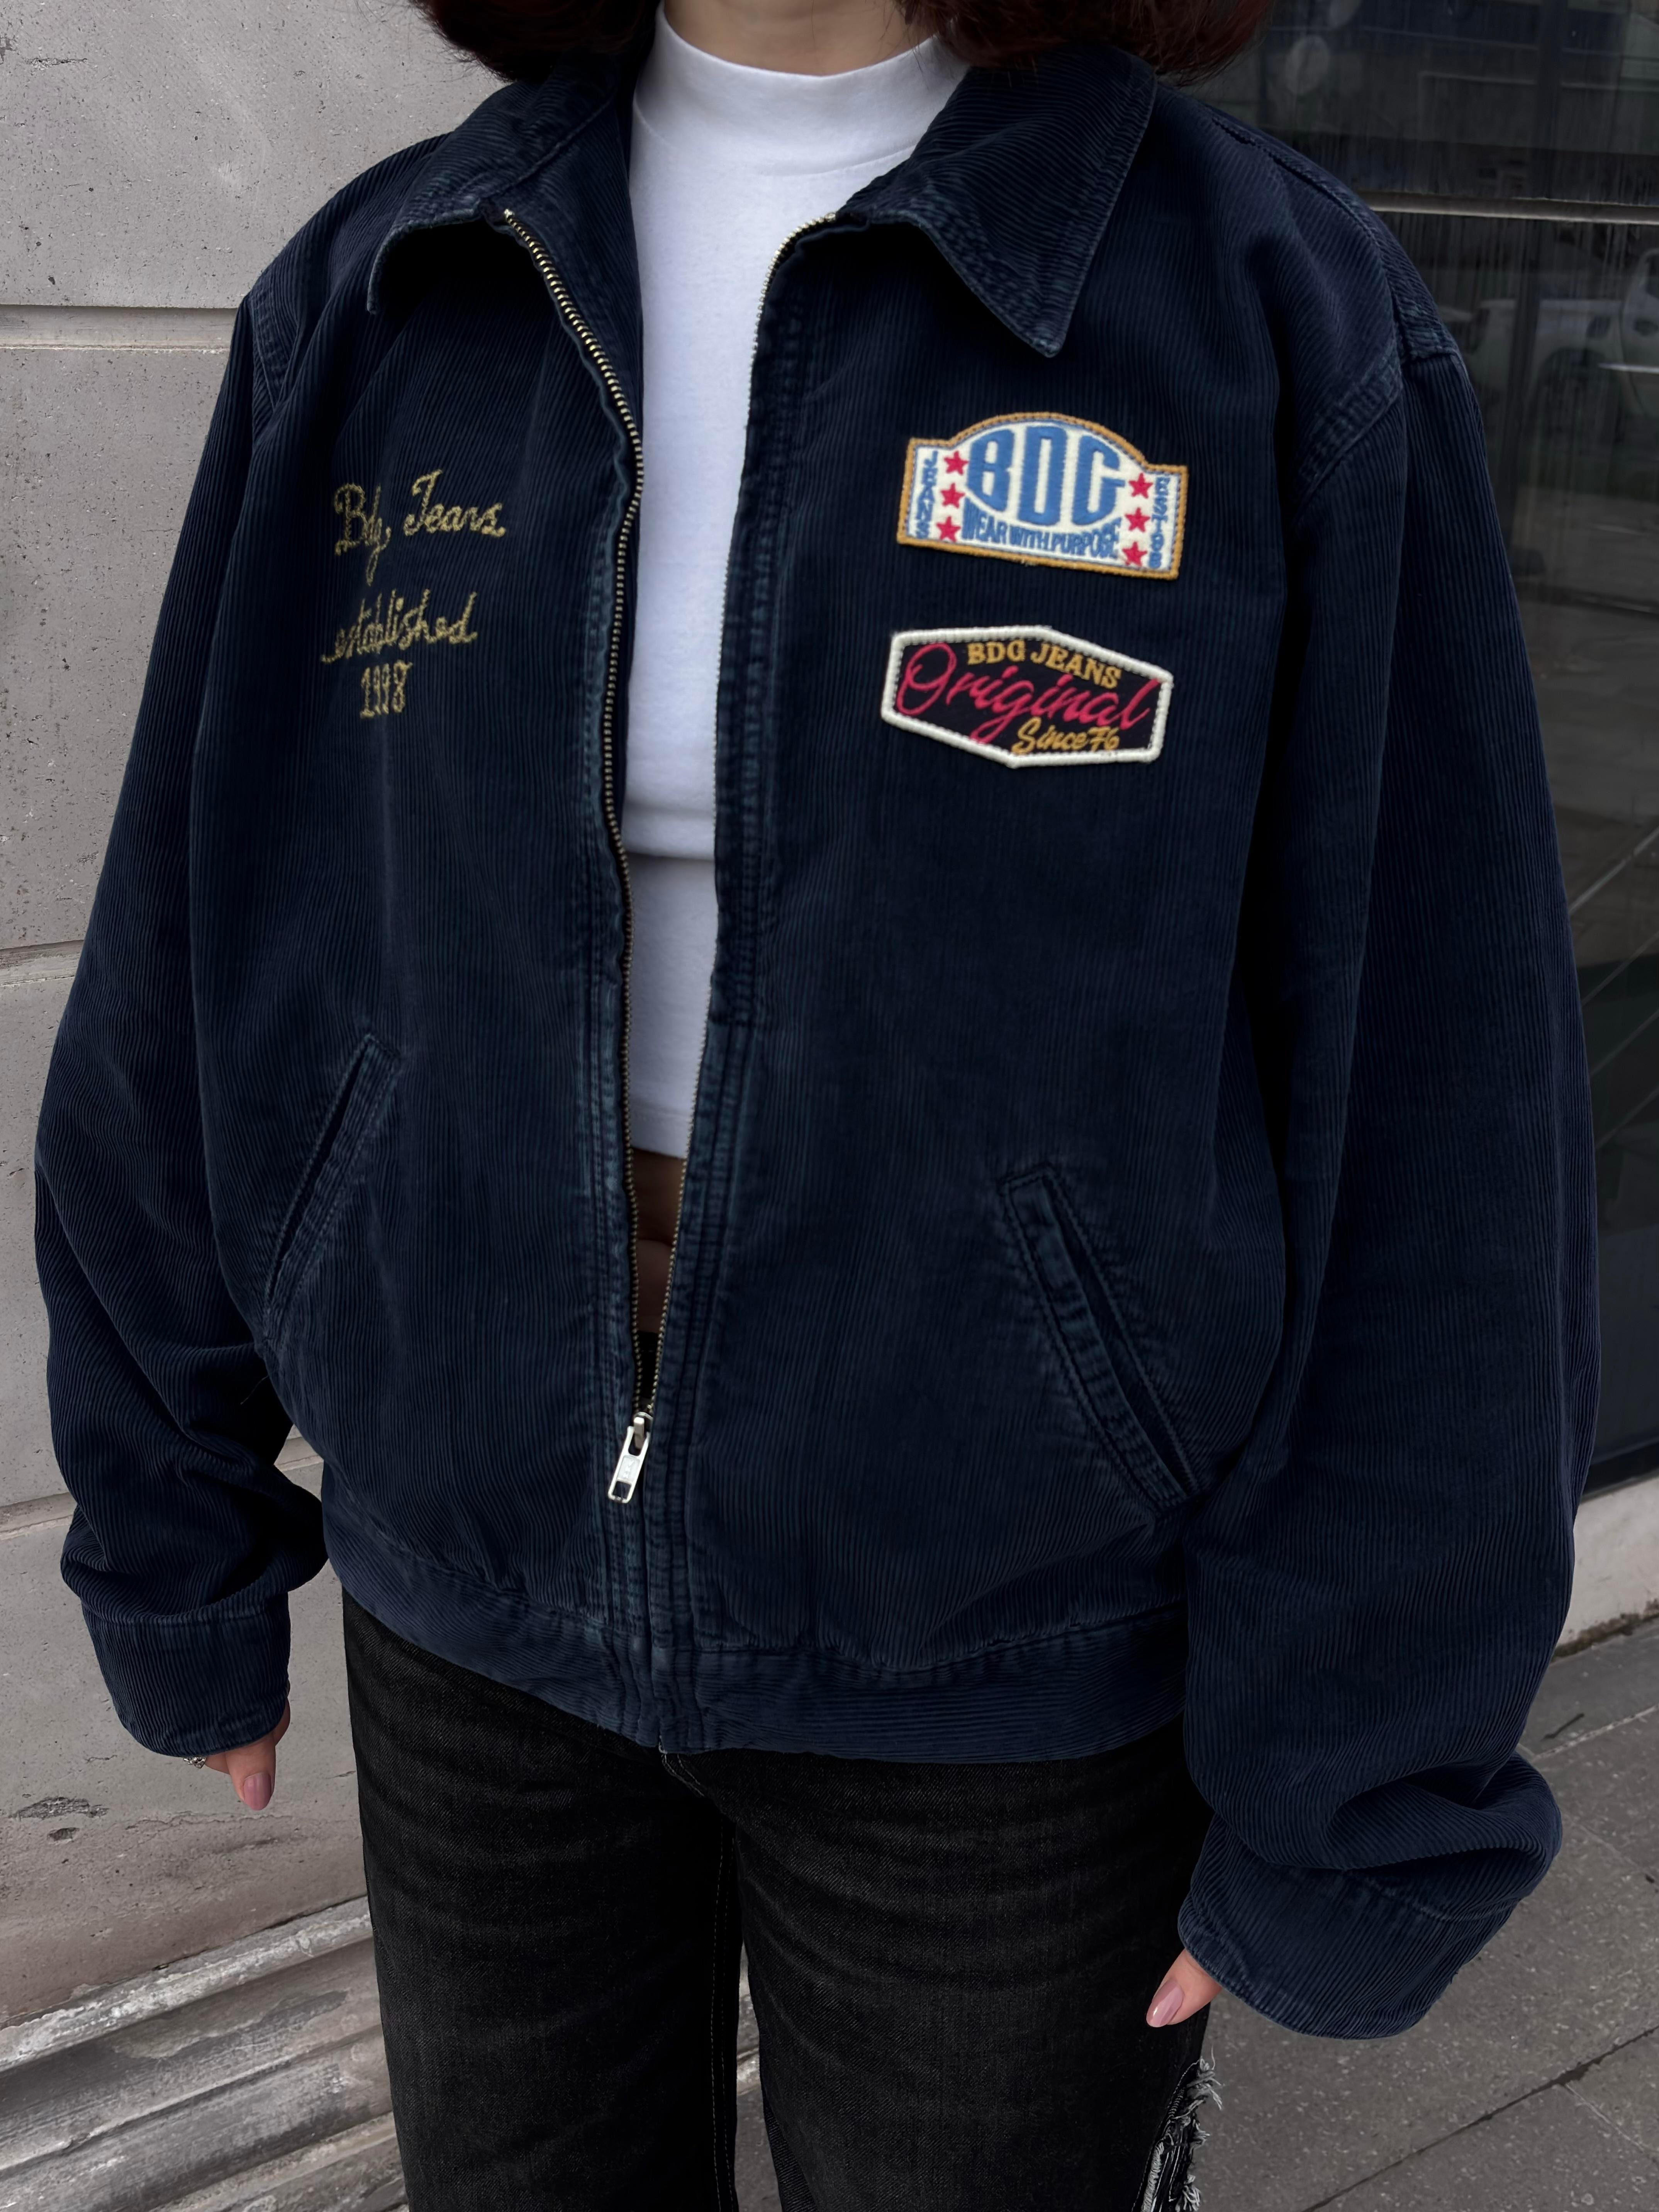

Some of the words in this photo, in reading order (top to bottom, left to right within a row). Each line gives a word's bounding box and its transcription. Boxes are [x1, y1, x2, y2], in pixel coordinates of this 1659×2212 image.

[403, 468, 507, 537] Jeans
[965, 425, 1125, 527] BDG
[960, 497, 1008, 544] WEAR
[1008, 524, 1050, 552] WITH
[1051, 516, 1122, 560] PURPOSE
[321, 588, 478, 663] established
[896, 642, 1160, 745] Original
[966, 638, 1026, 666] BDG
[1030, 642, 1122, 690] JEANS
